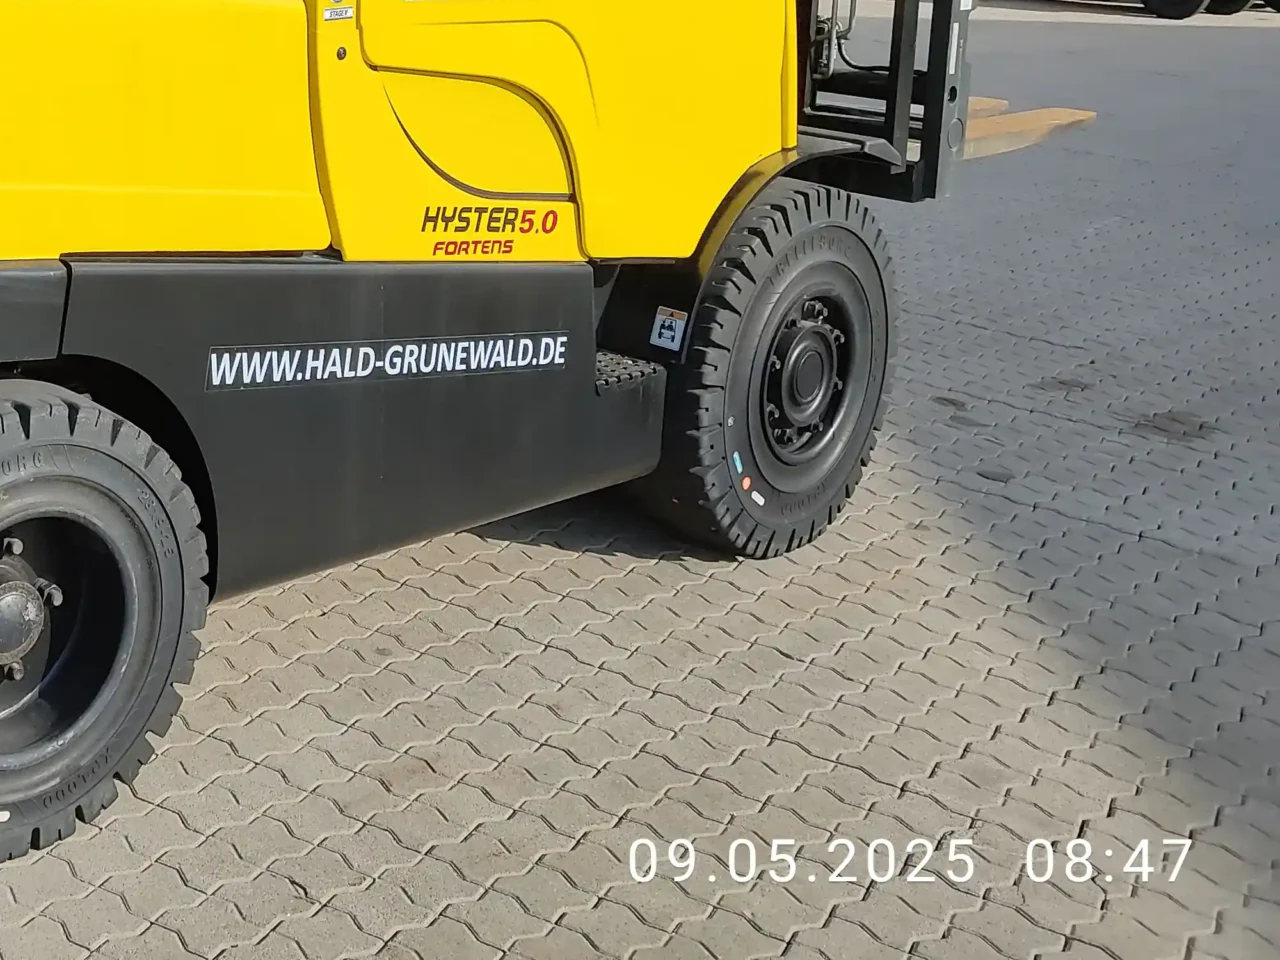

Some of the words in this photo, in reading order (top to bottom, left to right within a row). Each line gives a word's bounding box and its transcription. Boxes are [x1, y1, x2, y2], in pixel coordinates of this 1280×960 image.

[421, 206, 519, 233] HYSTER
[519, 209, 558, 234] 5.0
[432, 239, 514, 256] FORTENS
[210, 337, 568, 386] WWW.HALD-GRUNEWALD.DE
